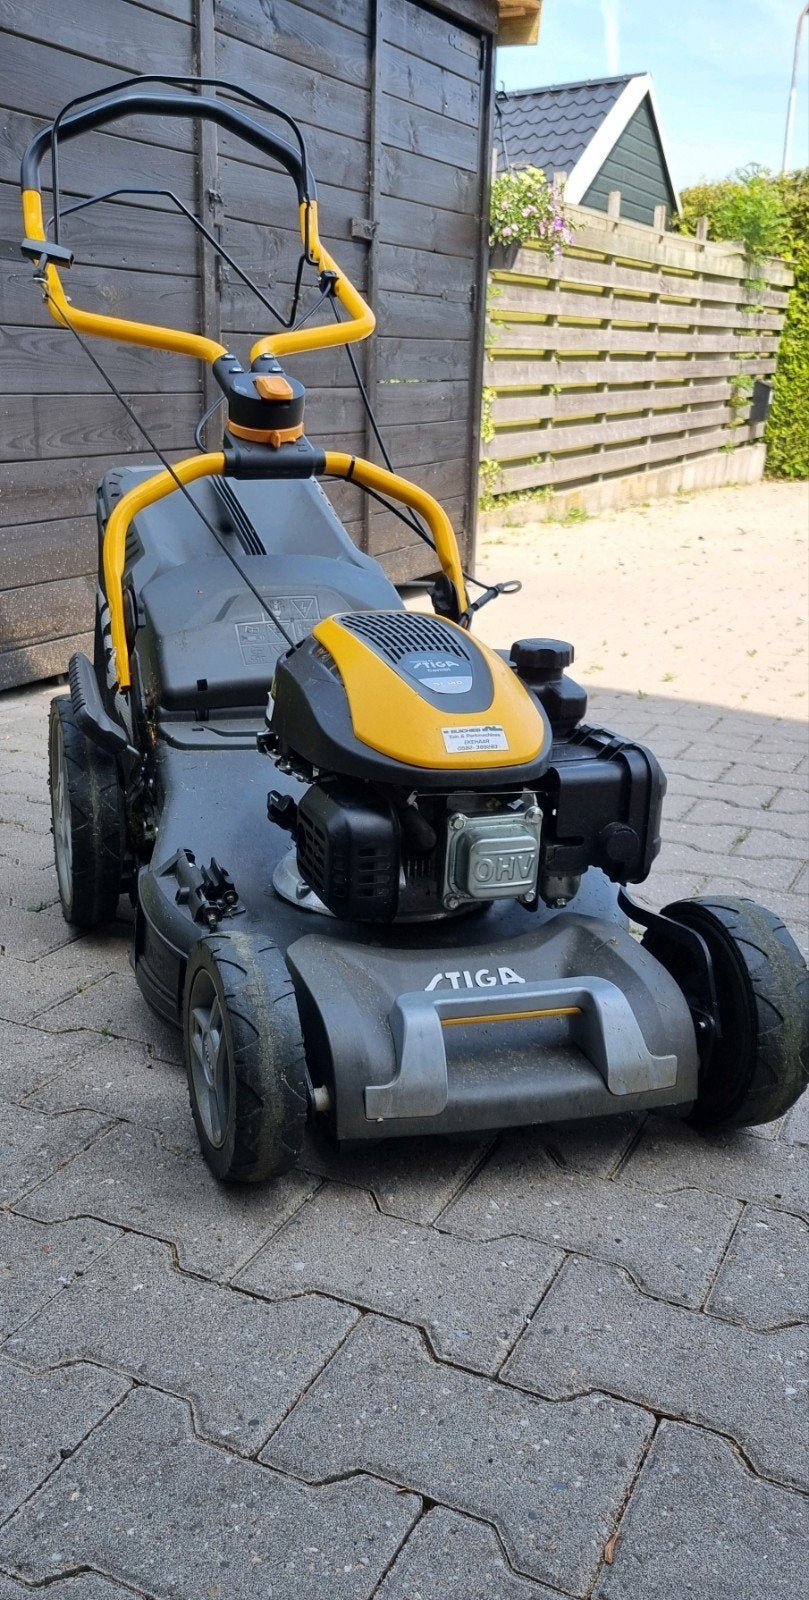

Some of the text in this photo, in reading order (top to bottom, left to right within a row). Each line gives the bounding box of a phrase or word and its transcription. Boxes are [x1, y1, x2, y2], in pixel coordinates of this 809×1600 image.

[413, 659, 460, 669] STIGA
[474, 854, 535, 883] OHV
[424, 966, 526, 992] STIGA
